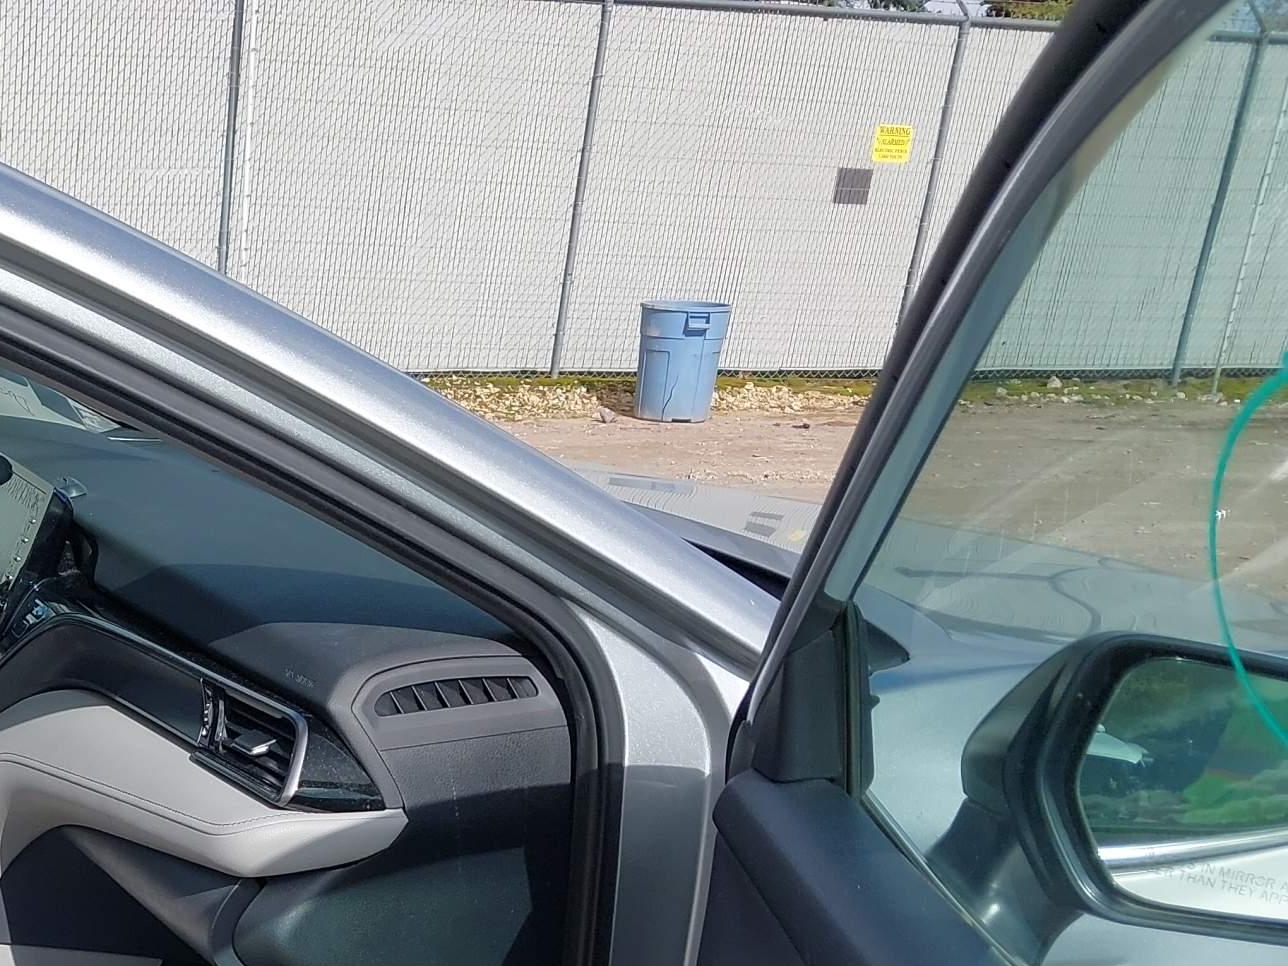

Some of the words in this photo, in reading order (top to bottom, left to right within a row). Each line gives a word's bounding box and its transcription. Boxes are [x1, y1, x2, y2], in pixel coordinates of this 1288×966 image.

[880, 126, 911, 136] WARNING
[1179, 869, 1217, 888] THAN
[1220, 880, 1254, 898] THEY
[1201, 863, 1217, 875] IN
[1219, 867, 1276, 890] MIRROR
